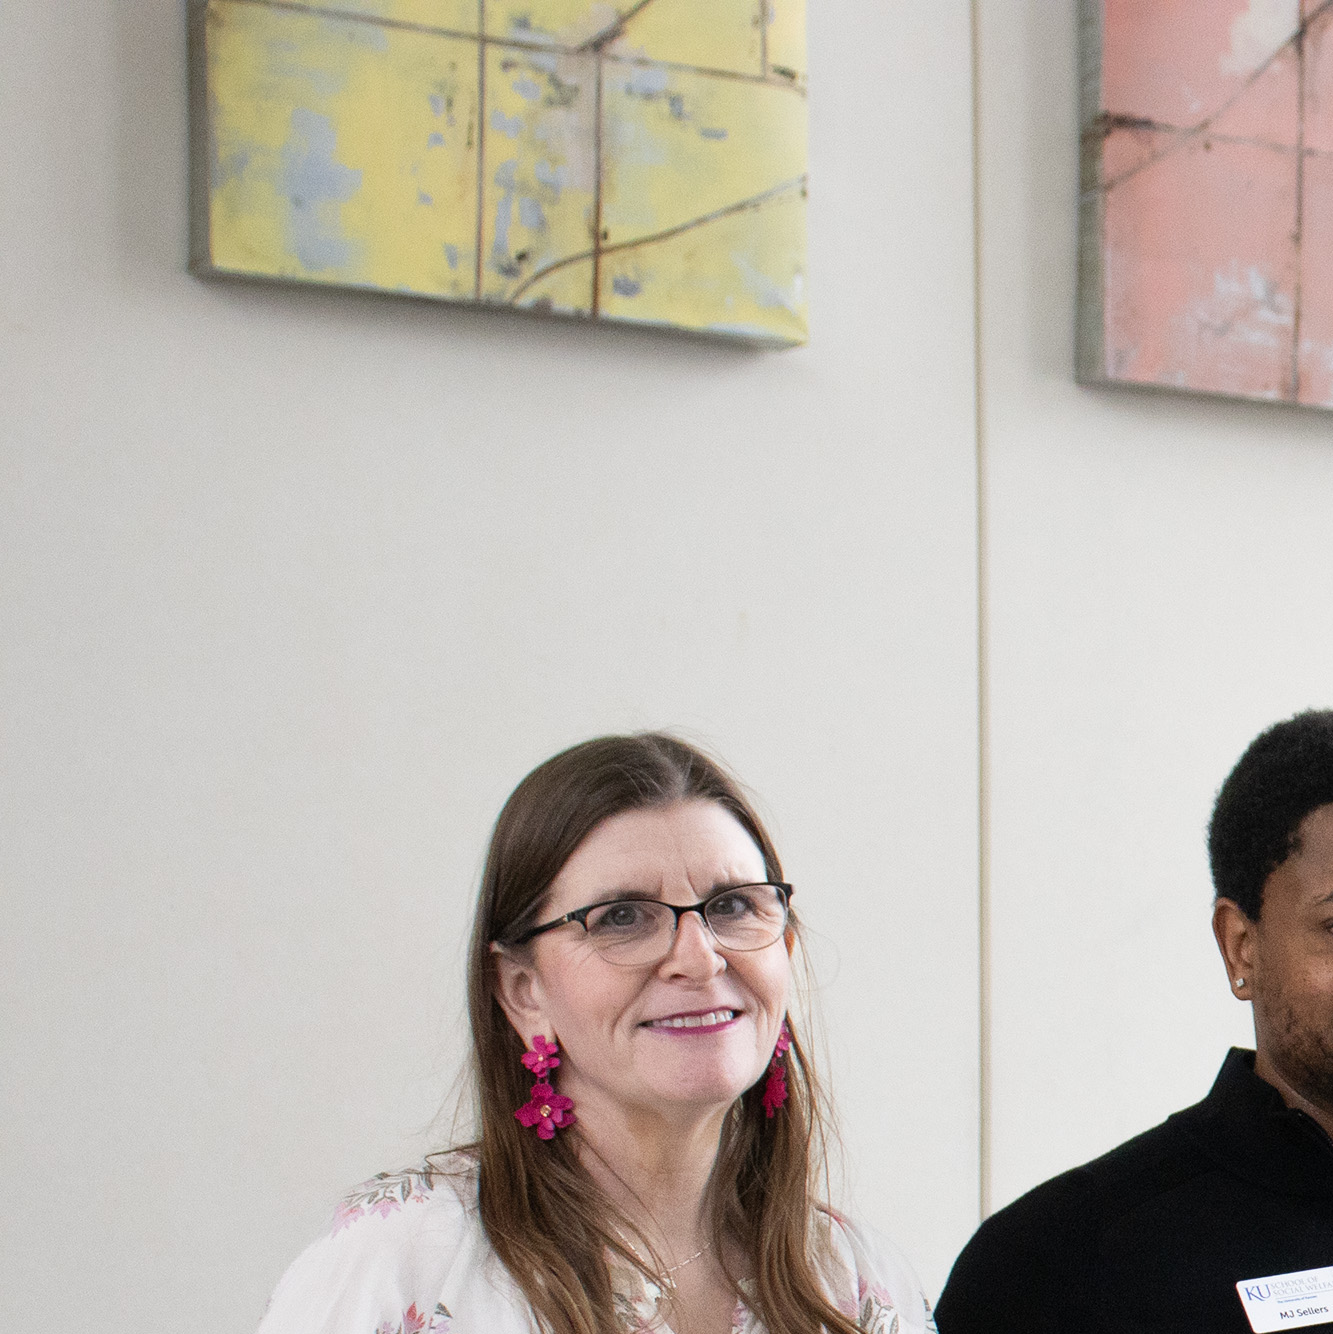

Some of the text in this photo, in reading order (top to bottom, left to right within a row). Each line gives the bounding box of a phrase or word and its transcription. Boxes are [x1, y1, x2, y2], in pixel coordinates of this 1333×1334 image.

[1245, 1284, 1271, 1302] KU
[1280, 1305, 1329, 1320] MJ Sellers
